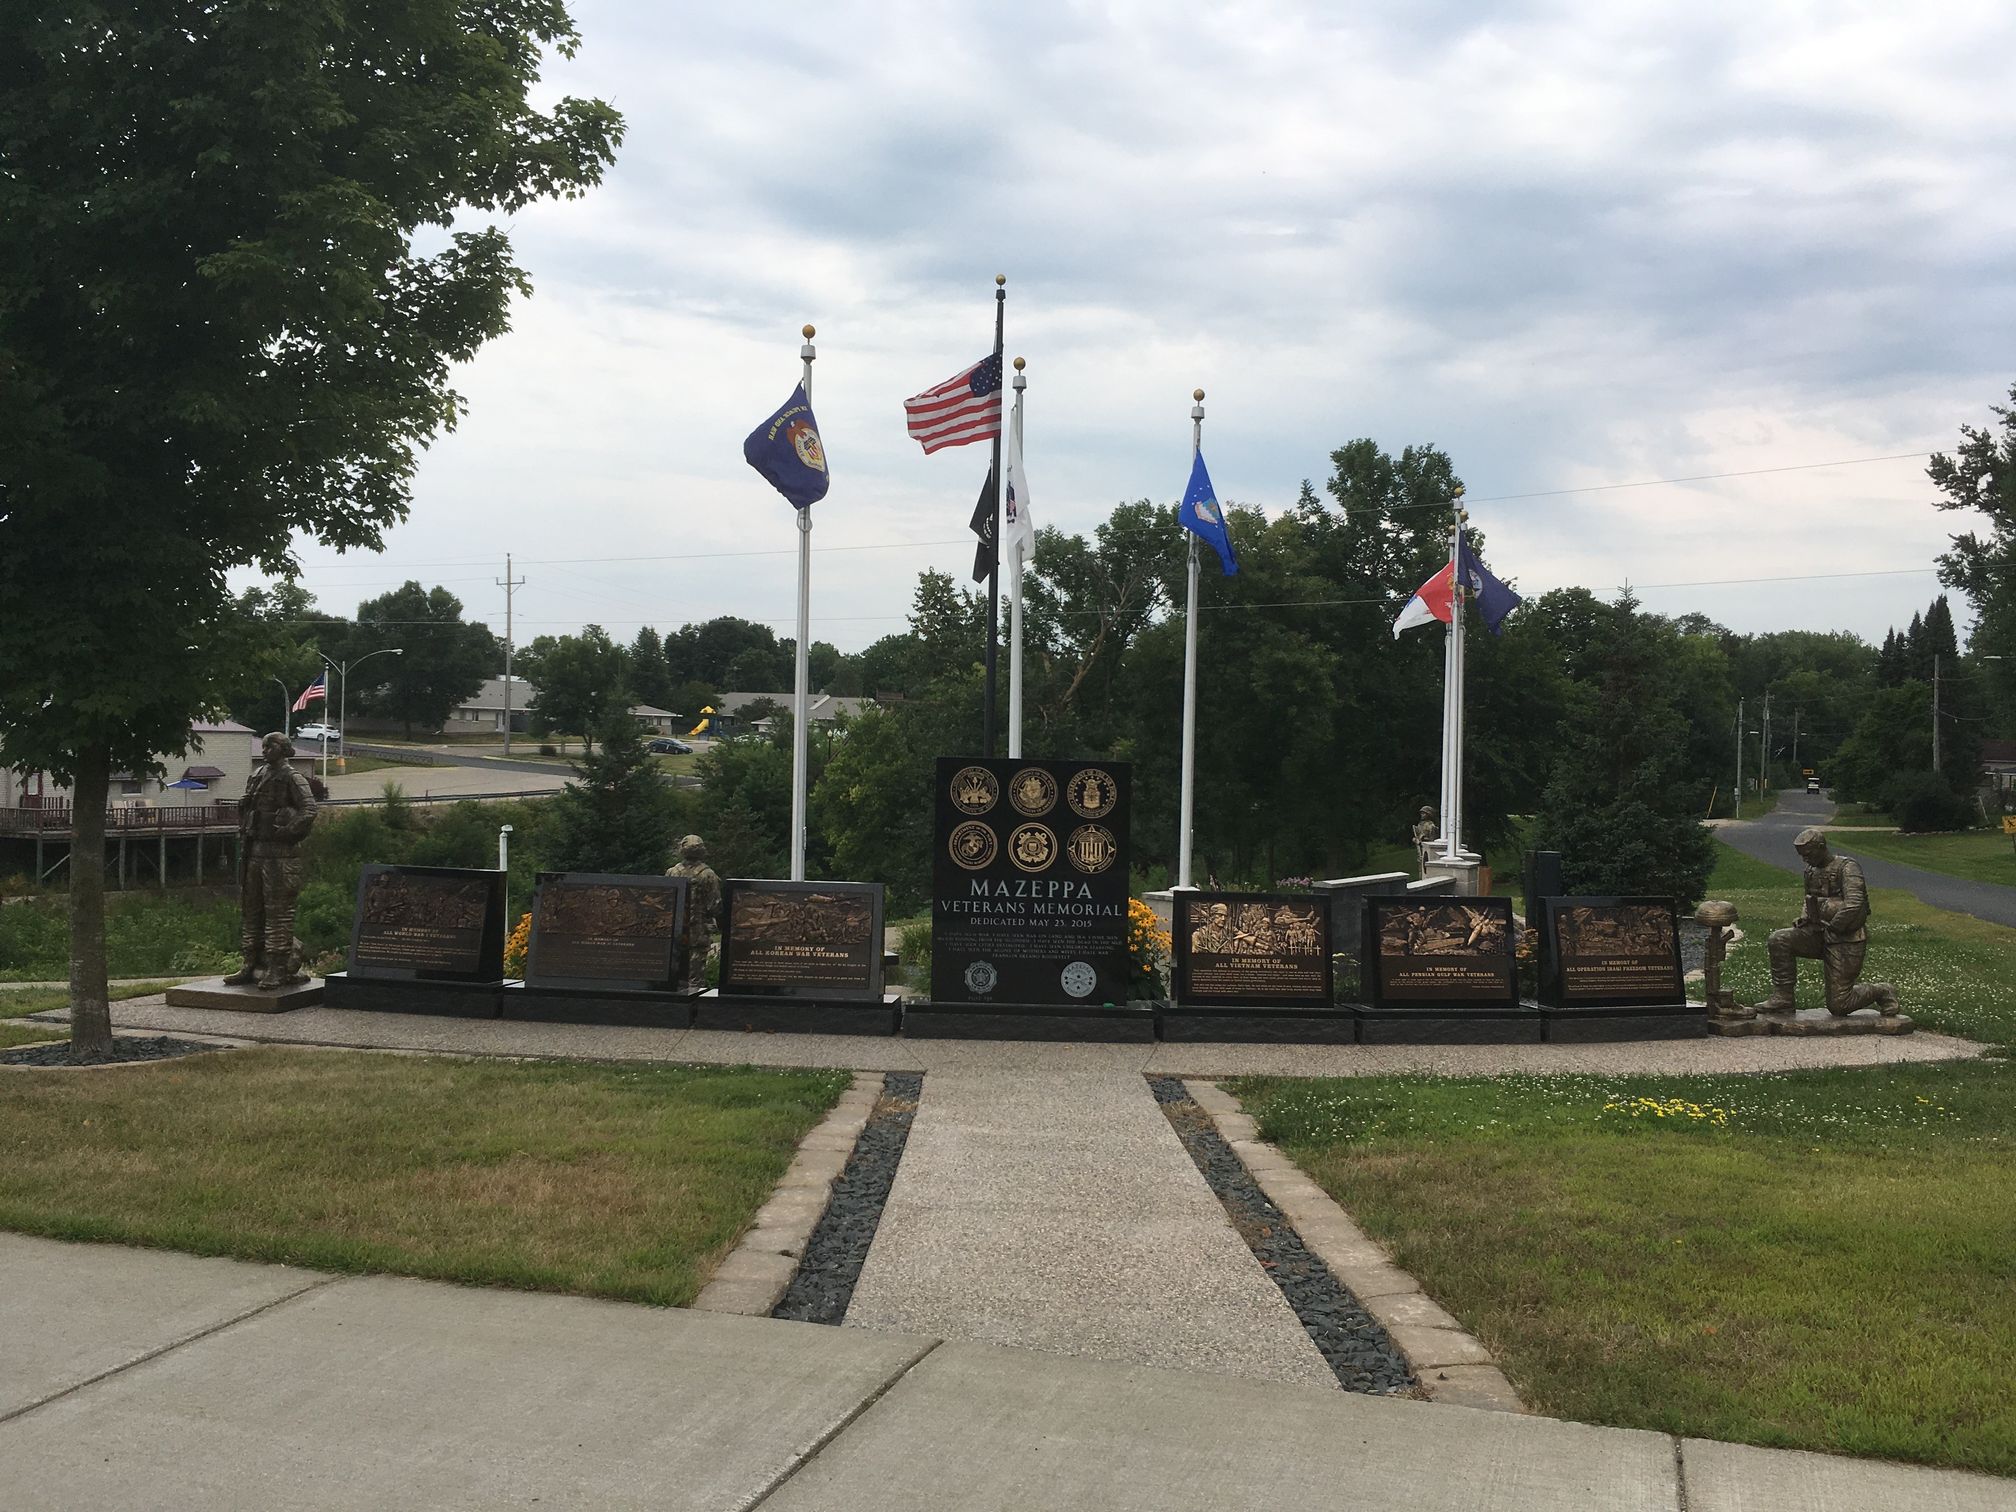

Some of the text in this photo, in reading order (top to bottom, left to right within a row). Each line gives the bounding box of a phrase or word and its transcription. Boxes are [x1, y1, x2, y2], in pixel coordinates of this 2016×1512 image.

[970, 878, 1092, 899] MAZEPPA
[941, 900, 1122, 916] VETERANS MEMORIAL
[970, 917, 1025, 926] DEDICATED
[1029, 918, 1050, 927] MAY
[1072, 920, 1092, 928] 2015
